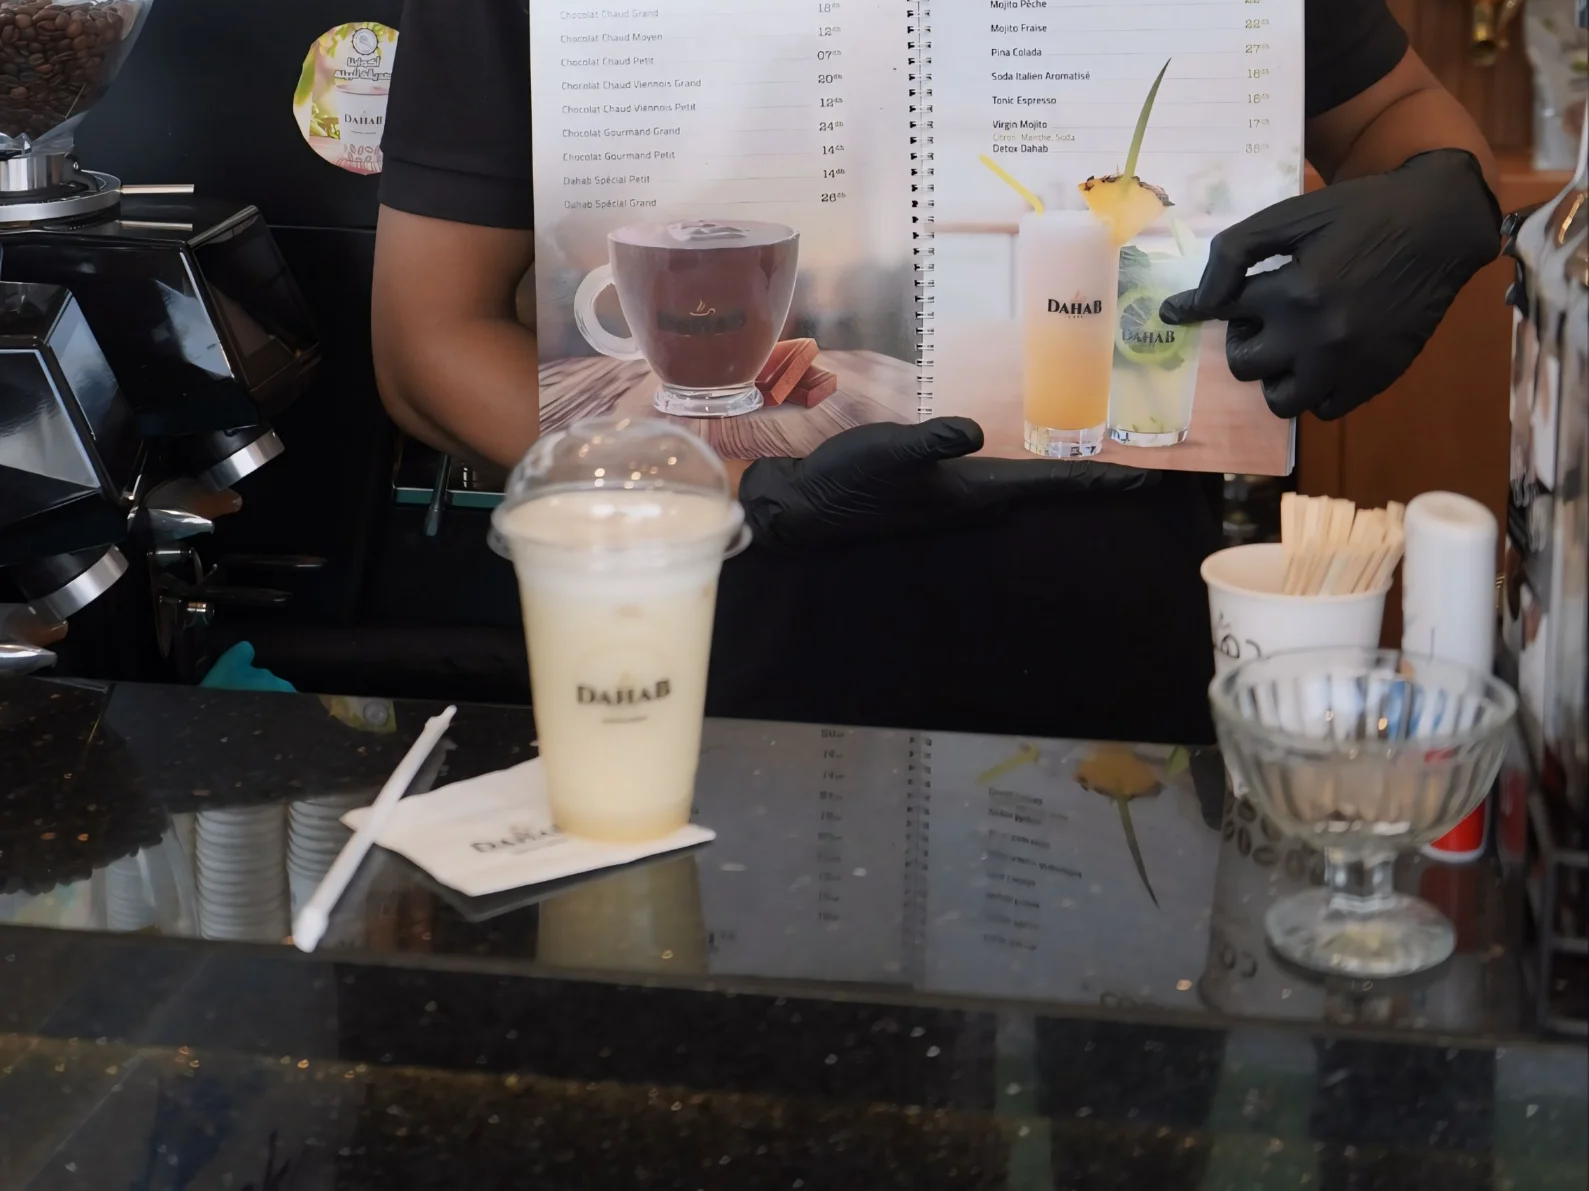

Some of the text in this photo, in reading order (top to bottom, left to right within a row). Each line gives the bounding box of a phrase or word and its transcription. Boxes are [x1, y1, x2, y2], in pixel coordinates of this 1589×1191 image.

[990, 0, 1018, 10] Mojito
[990, 24, 1019, 34] Mojito
[1020, 23, 1048, 33] Fraise
[560, 34, 600, 44] Chocolat
[602, 34, 630, 43] Chaud
[632, 33, 663, 44] Moyen
[1012, 47, 1042, 57] Colada
[561, 58, 600, 67] Chocolat
[602, 57, 631, 66] Chaud
[633, 57, 655, 65] Petit
[991, 72, 1014, 81] Soda
[1015, 72, 1043, 81] Italien
[1045, 71, 1091, 81] Aromatisé
[561, 81, 600, 91] Chocolat
[603, 80, 631, 90] Chaud
[633, 80, 672, 89] Viennois
[674, 79, 702, 88] Grand
[992, 96, 1014, 105] Tonic
[1016, 95, 1057, 106] Espresso
[561, 105, 601, 115] Chocolat
[603, 105, 632, 114] Chaud
[633, 104, 672, 113] Viennois
[674, 103, 697, 112] Petit
[344, 113, 383, 125] DAHAB
[992, 120, 1018, 131] Virgin
[1020, 120, 1048, 131] Mojito
[562, 129, 601, 138] Chocolat
[603, 127, 651, 137] Gourmand
[653, 126, 681, 136] Grand
[992, 144, 1018, 153] Detox
[1020, 144, 1049, 153] Dahab
[562, 153, 602, 162] Chocolat
[604, 151, 652, 161] Gourmand
[654, 150, 676, 159] Petit
[563, 176, 592, 186] Dahab
[629, 175, 650, 184] Petit
[564, 200, 593, 209] Dahab
[629, 198, 657, 208] Grand
[1047, 298, 1103, 315] DAHAB
[1121, 329, 1176, 344] DAHAB
[576, 678, 671, 705] DAHAB
